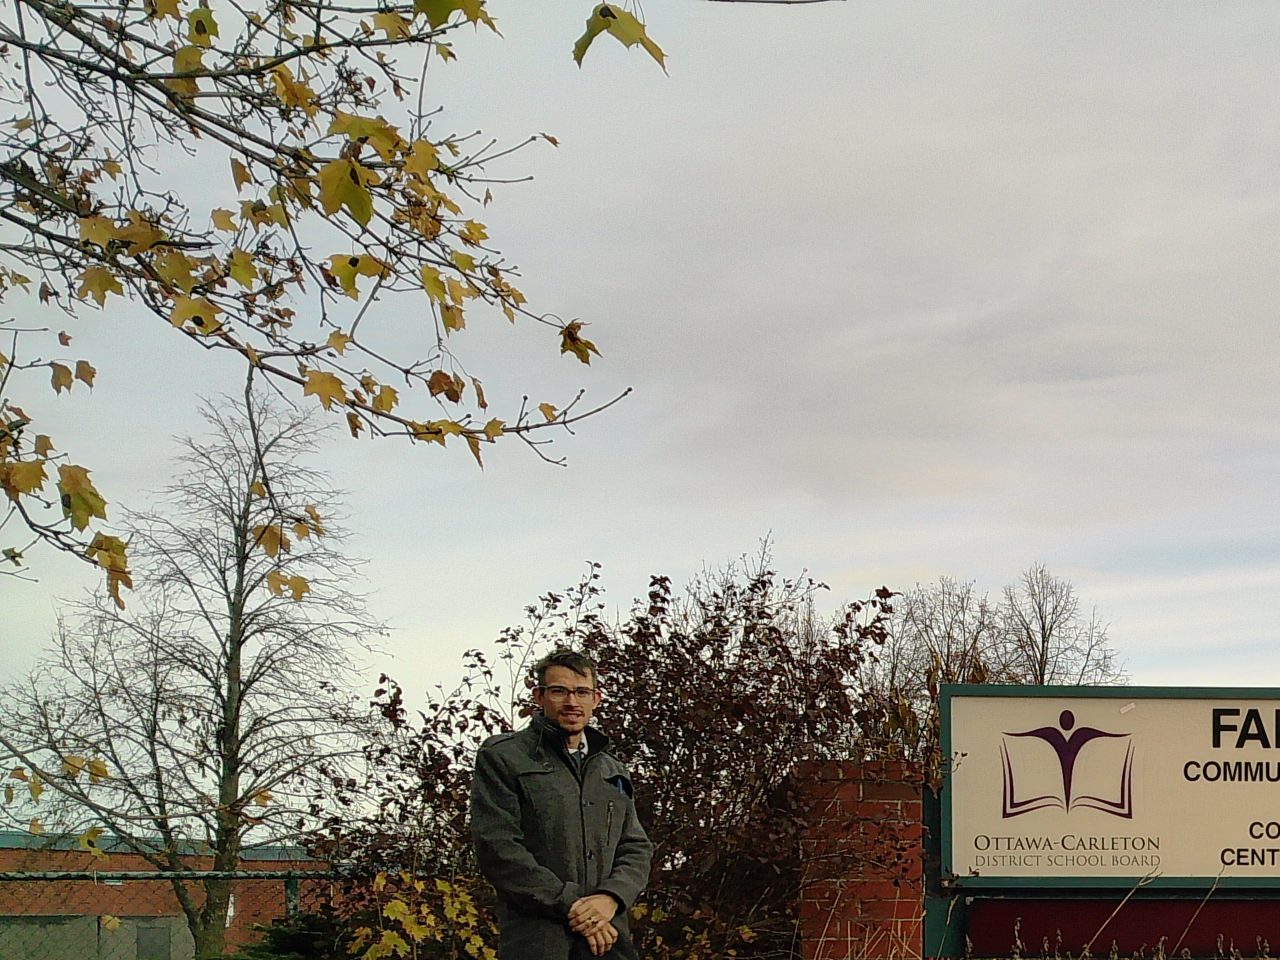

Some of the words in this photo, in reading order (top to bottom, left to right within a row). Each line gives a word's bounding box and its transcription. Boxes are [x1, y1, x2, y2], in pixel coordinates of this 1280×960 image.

[975, 854, 1043, 867] DISTRICT
[1047, 854, 1107, 867] SCHOOL
[1111, 854, 1161, 867] BOARD
